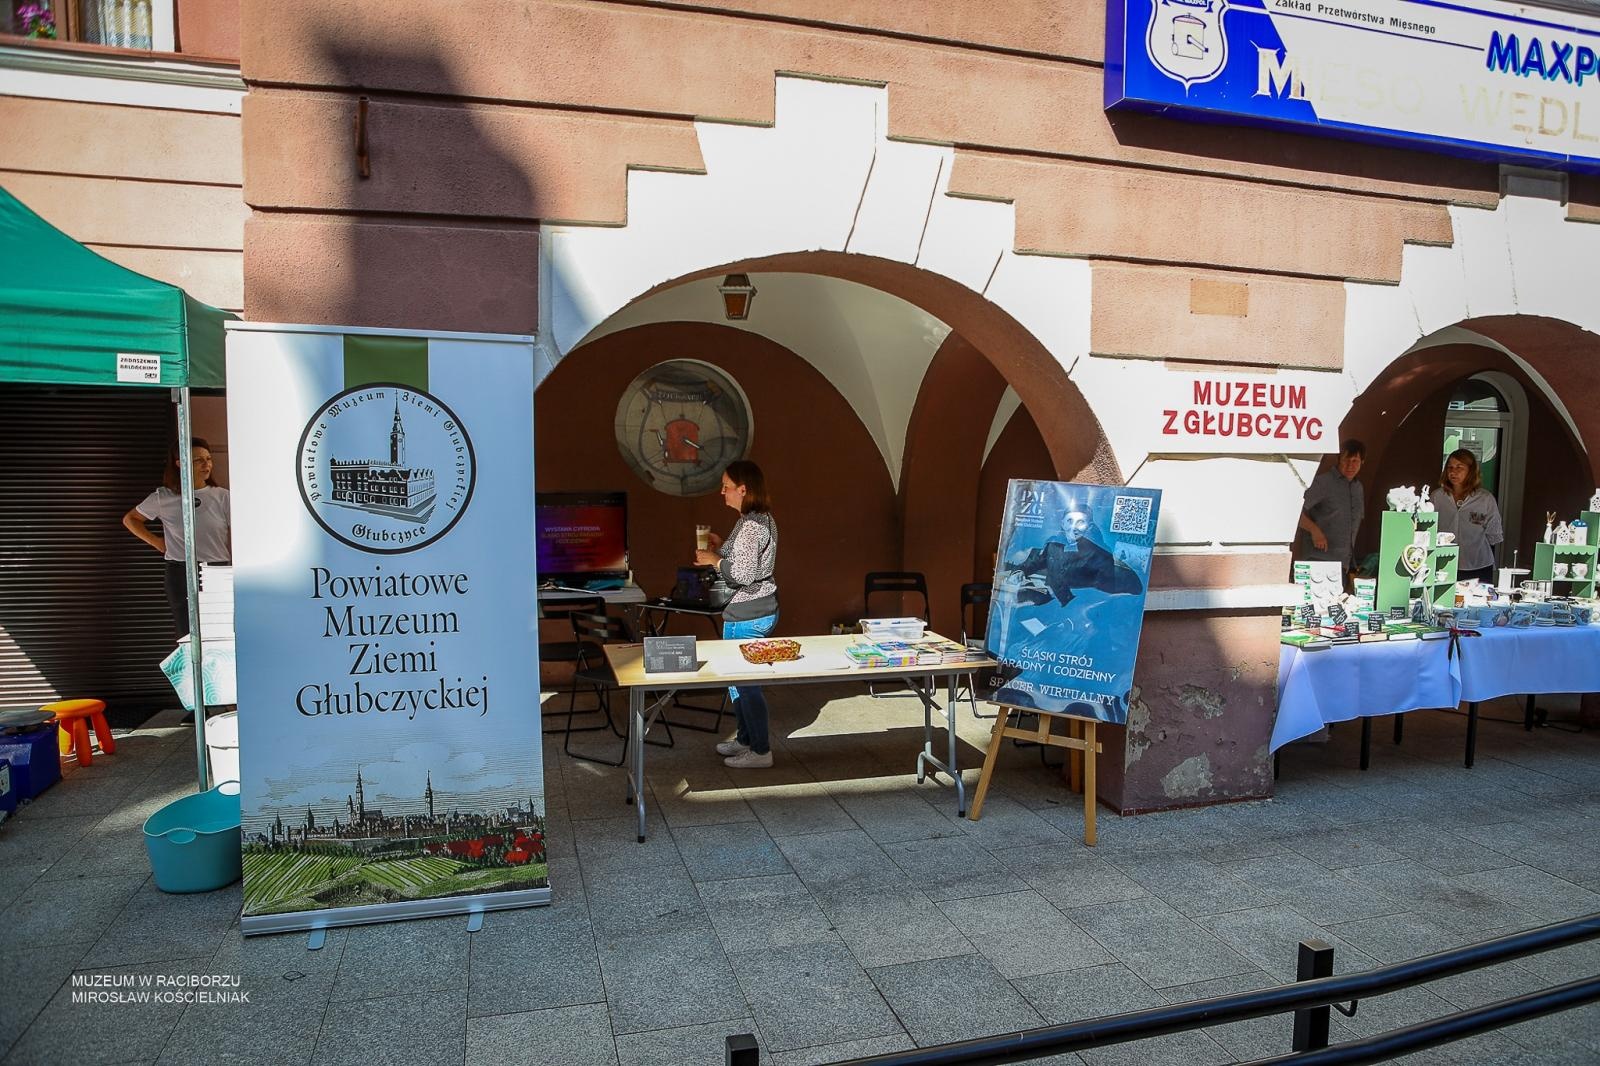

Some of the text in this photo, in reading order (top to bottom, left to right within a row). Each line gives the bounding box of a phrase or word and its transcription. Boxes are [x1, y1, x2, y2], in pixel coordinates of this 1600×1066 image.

[1274, 0, 1437, 35] Zakład Przetwórstwa Mięsnego
[1486, 30, 1600, 87] MAXP
[1193, 380, 1307, 410] MUZEUM
[1162, 409, 1323, 441] Z GŁUBCZYC
[305, 422, 327, 502] Powiatowe
[327, 390, 386, 418] Muzeum
[402, 391, 441, 418] Ziemi
[351, 523, 427, 544] Głubczyce
[310, 565, 469, 599] Powiatowe
[322, 604, 460, 638] Muzeum
[349, 640, 438, 675] Ziemi
[996, 656, 1046, 673] PARADNY
[1053, 665, 1117, 683] CODZIENNY
[1021, 646, 1094, 668] ŚLĄSKI STRÓJ
[295, 676, 489, 721] Głubczyckiej
[989, 676, 1117, 706] SPACER WIRTUALNY
